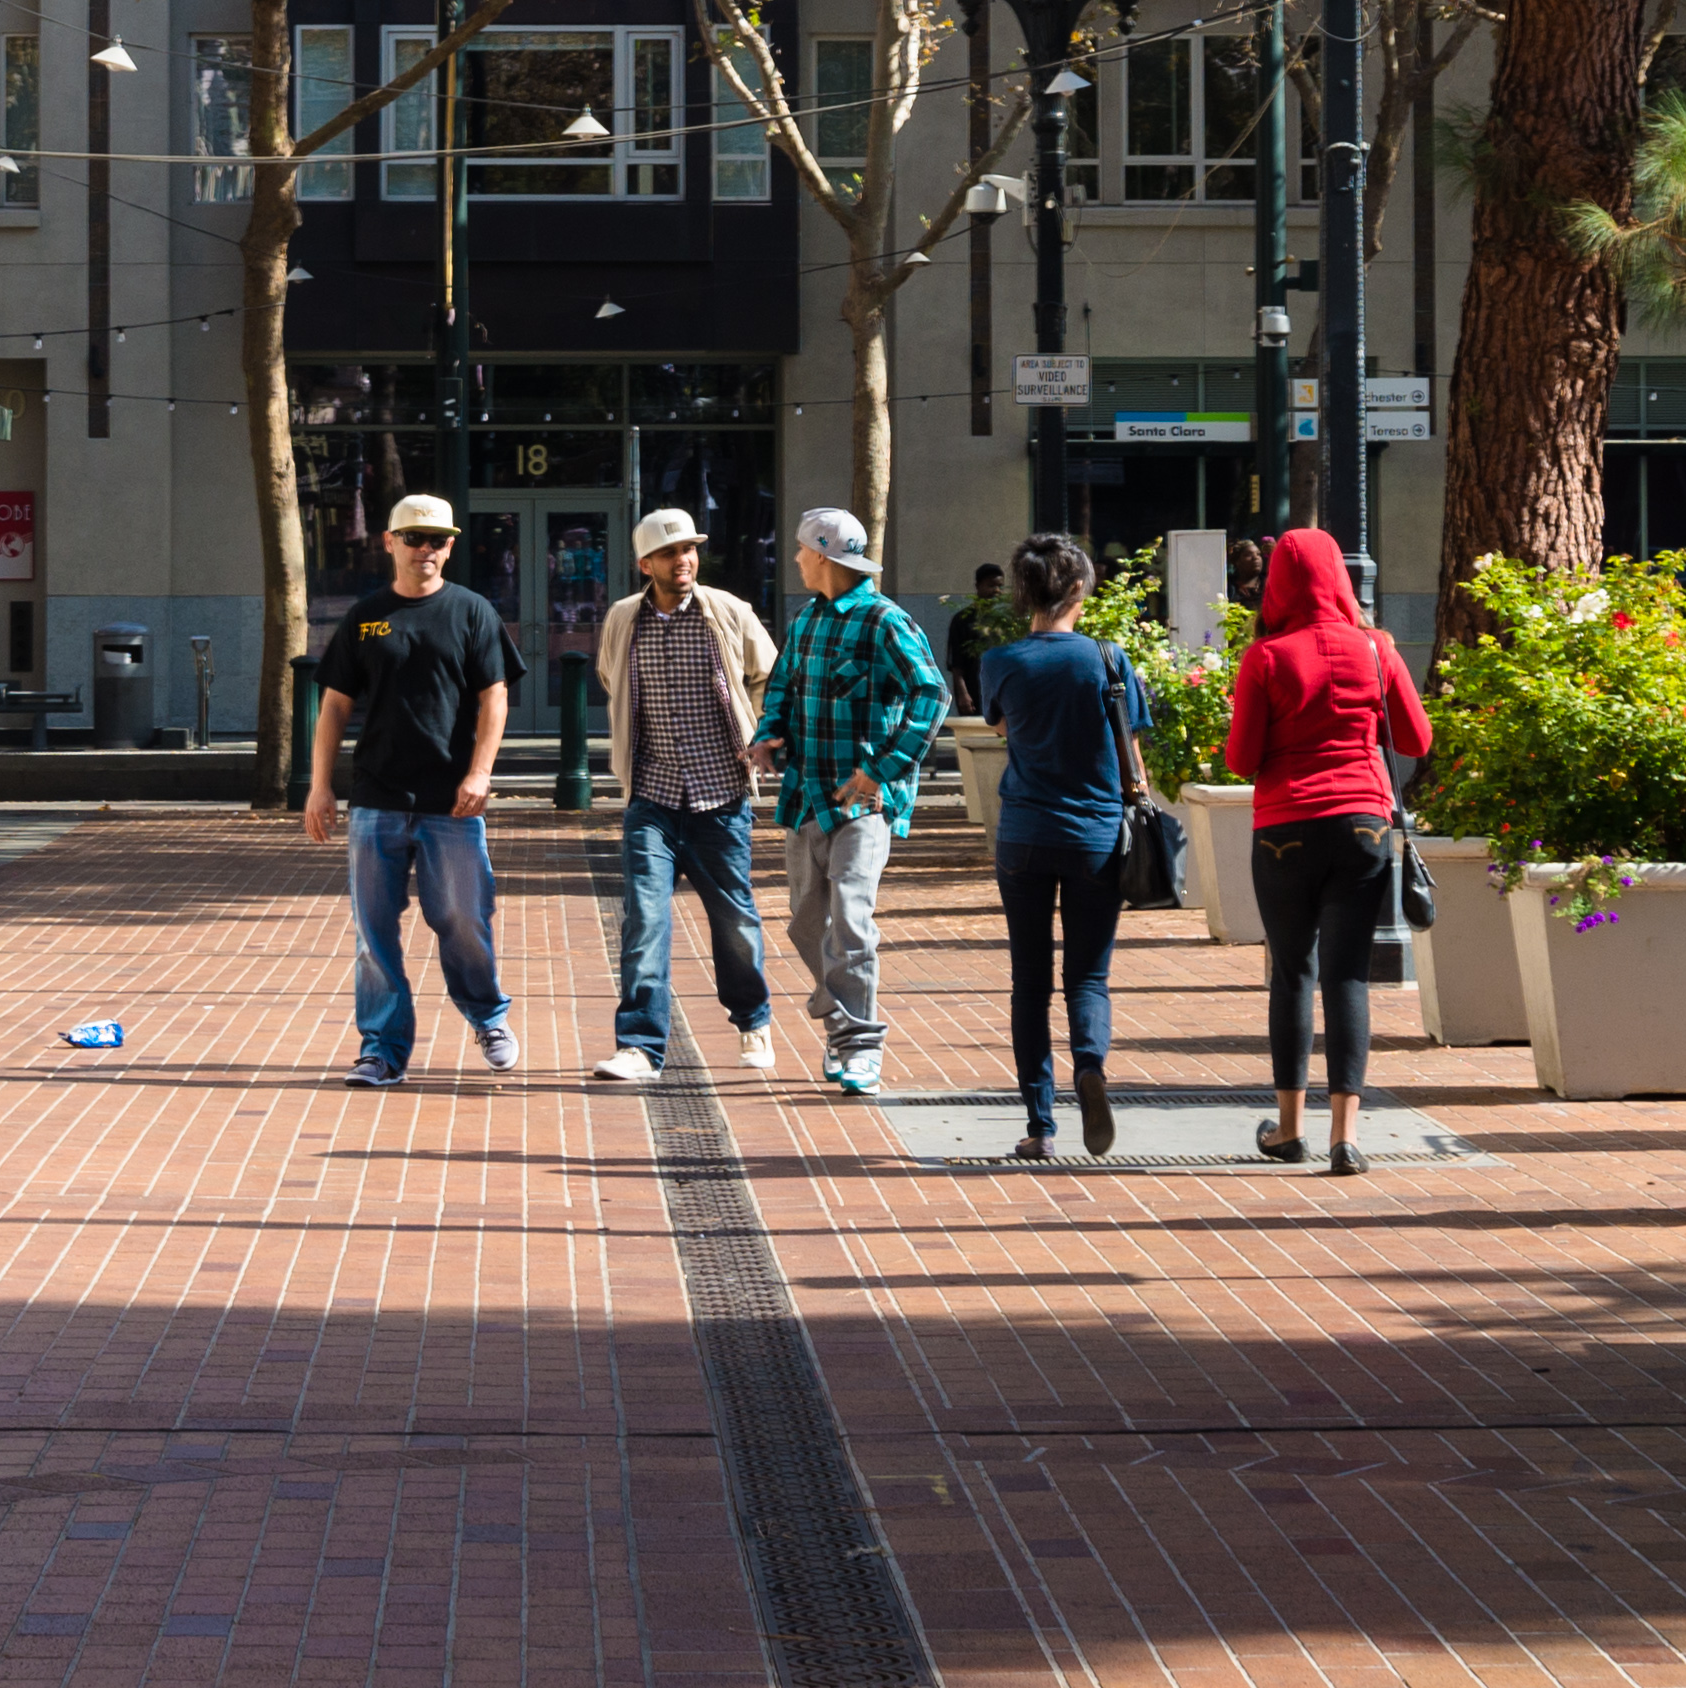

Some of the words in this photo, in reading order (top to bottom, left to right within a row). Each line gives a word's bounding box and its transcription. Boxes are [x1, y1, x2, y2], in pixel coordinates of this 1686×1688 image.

[1021, 359, 1040, 369] AREA
[1042, 359, 1073, 369] SUBJECT
[1075, 359, 1085, 369] TO
[1038, 370, 1067, 382] VIDEO
[1017, 384, 1089, 396] SURVEILLANCE
[1128, 425, 1167, 438] Santa
[1170, 425, 1206, 438] Clara
[1370, 425, 1409, 437] Teresa
[516, 443, 549, 476] 18
